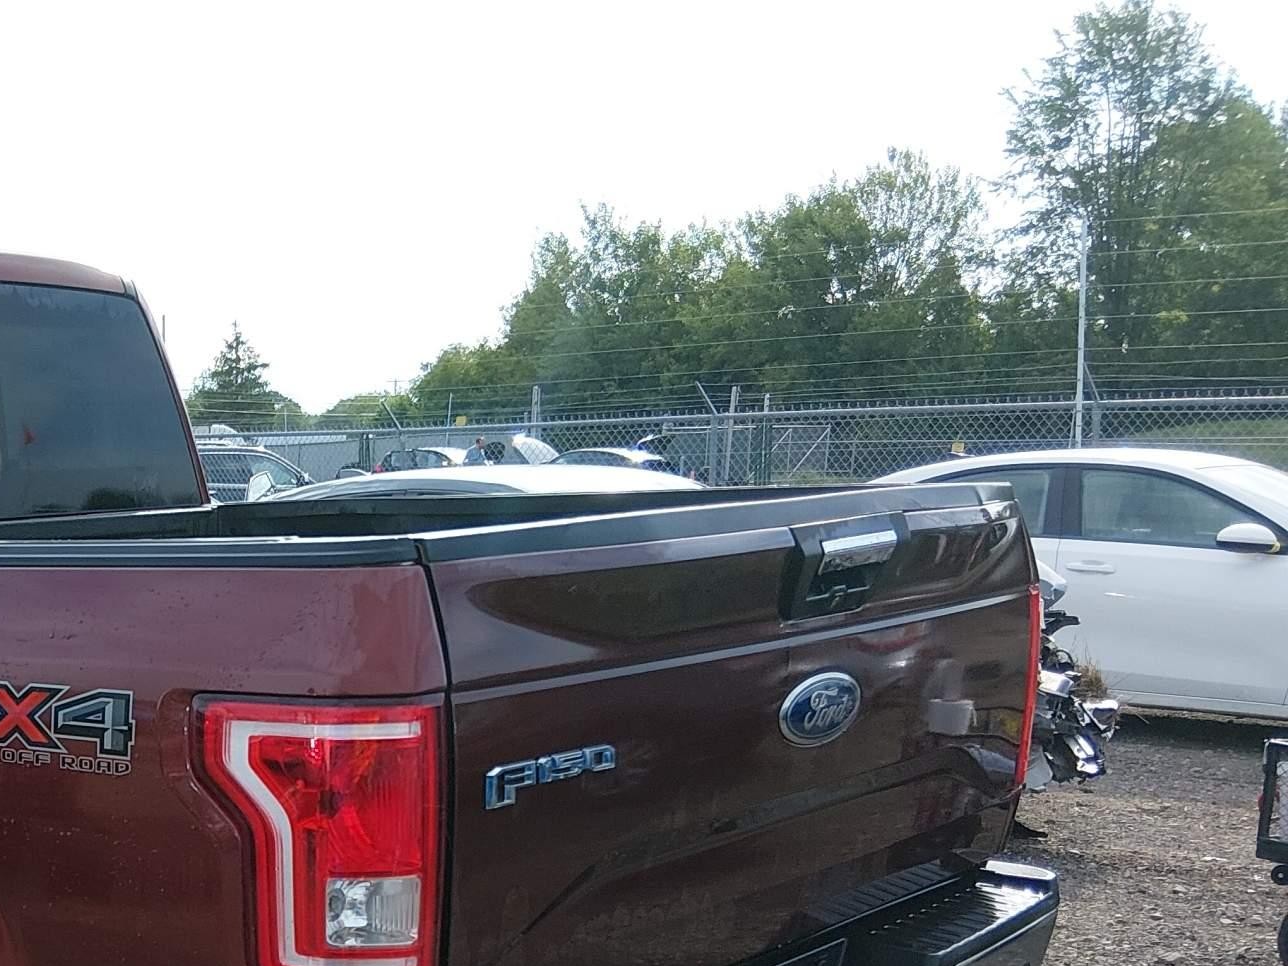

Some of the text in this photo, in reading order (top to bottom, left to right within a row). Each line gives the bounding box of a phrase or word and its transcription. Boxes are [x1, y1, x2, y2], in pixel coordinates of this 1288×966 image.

[803, 687, 849, 731] Ford
[0, 748, 132, 775] OFF ROAD
